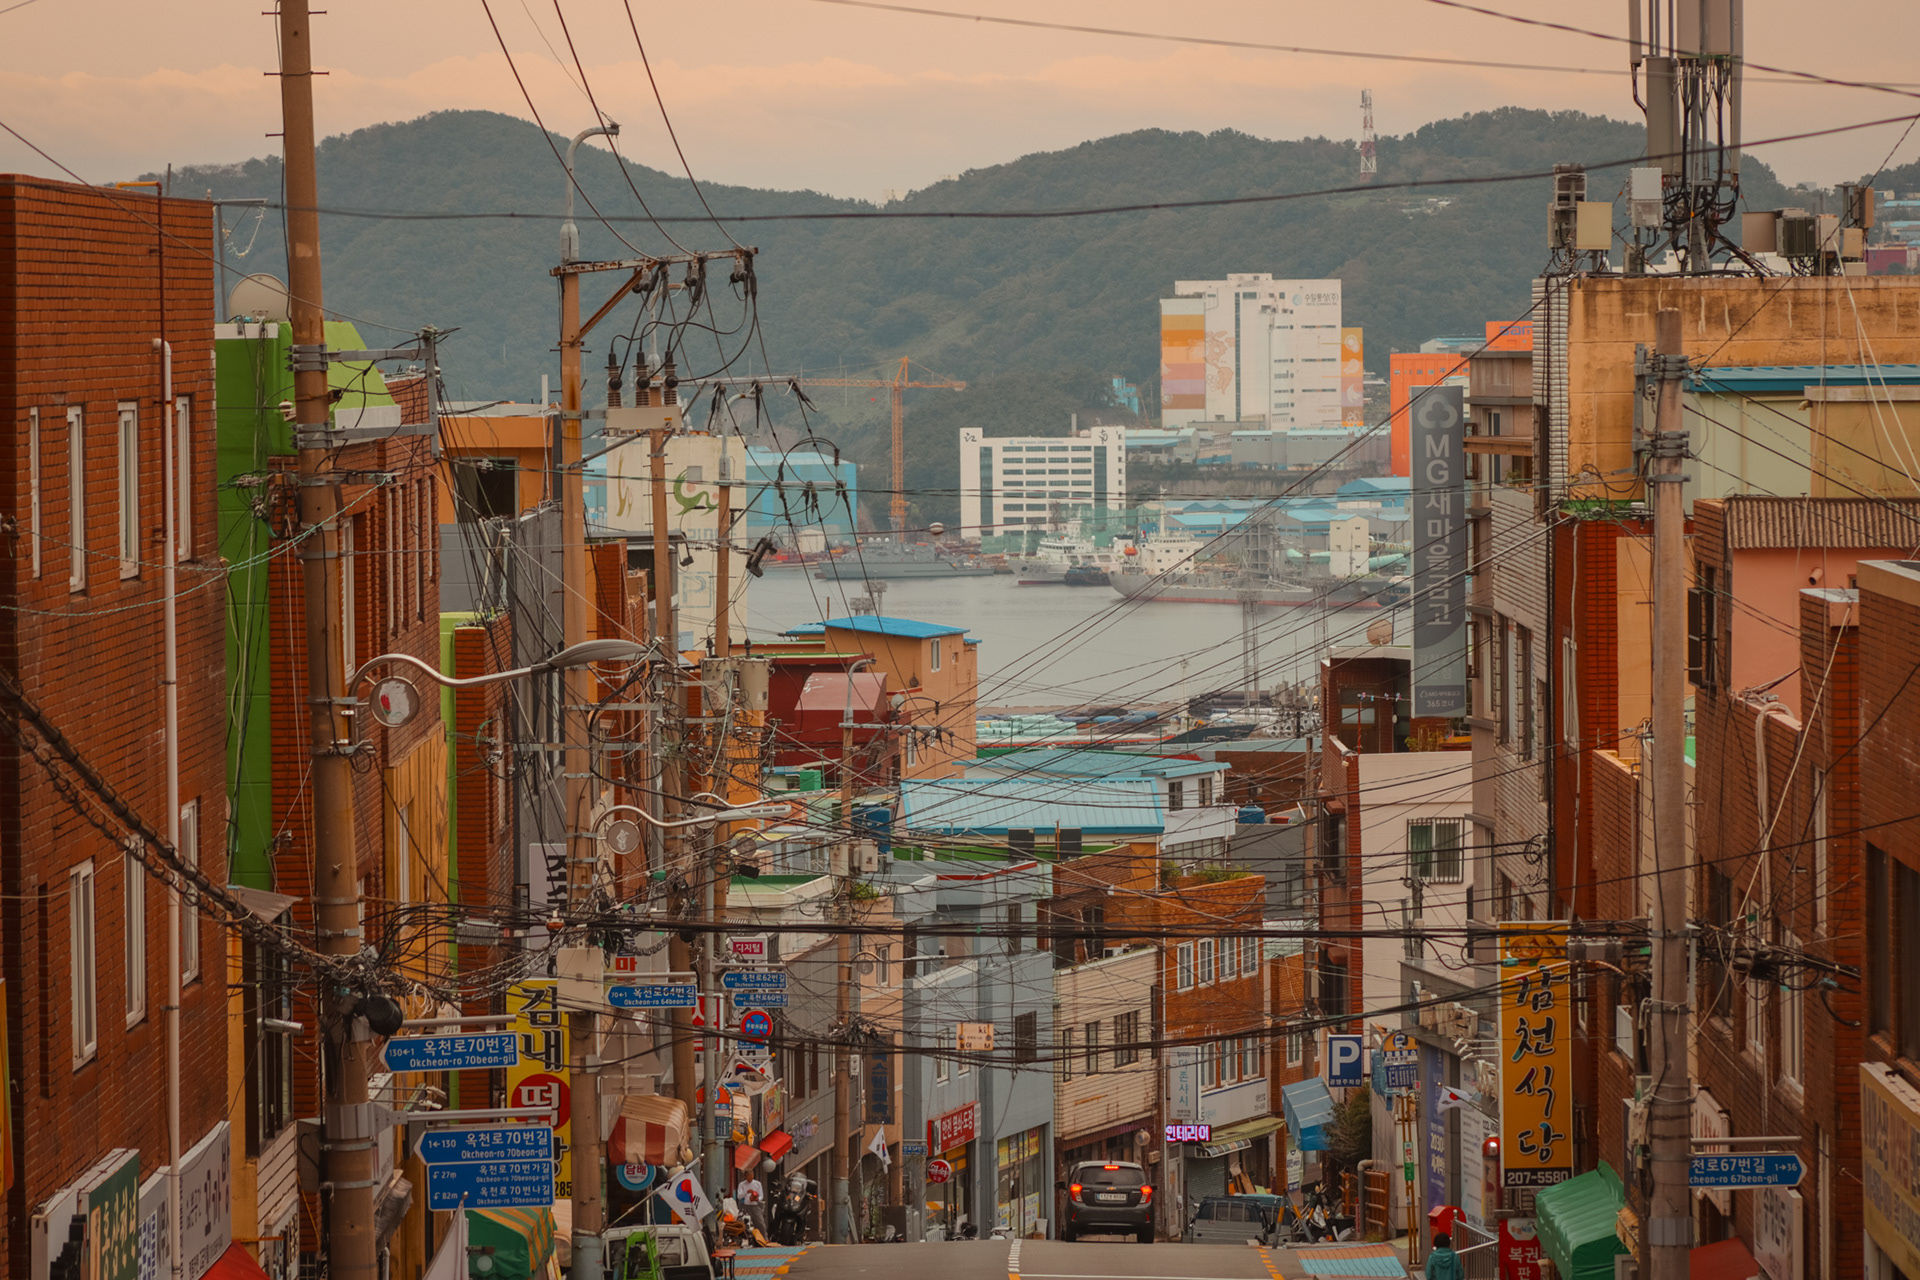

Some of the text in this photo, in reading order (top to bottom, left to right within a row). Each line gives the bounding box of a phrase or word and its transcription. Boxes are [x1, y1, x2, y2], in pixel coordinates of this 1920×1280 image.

[389, 1047, 415, 1057] 130 1
[423, 1036, 515, 1057] 옥천로70번길
[410, 1053, 515, 1068] Okcheon-ro 70beon-gil
[1331, 1039, 1361, 1076] P
[465, 1130, 548, 1148] 옥천로70번길
[1165, 1124, 1211, 1142] 인테리어
[428, 1139, 456, 1148] 1 130
[461, 1148, 548, 1159] Okcheon-ro 70beon-gil
[626, 1164, 647, 1176] 담배
[1787, 1163, 1798, 1171] 36
[441, 1171, 457, 1180] 27m
[1507, 1170, 1569, 1186] 207-5580
[1730, 1174, 1778, 1184] 67beon-gil
[442, 1192, 458, 1200] 82m
[1508, 1247, 1539, 1264] 복권
